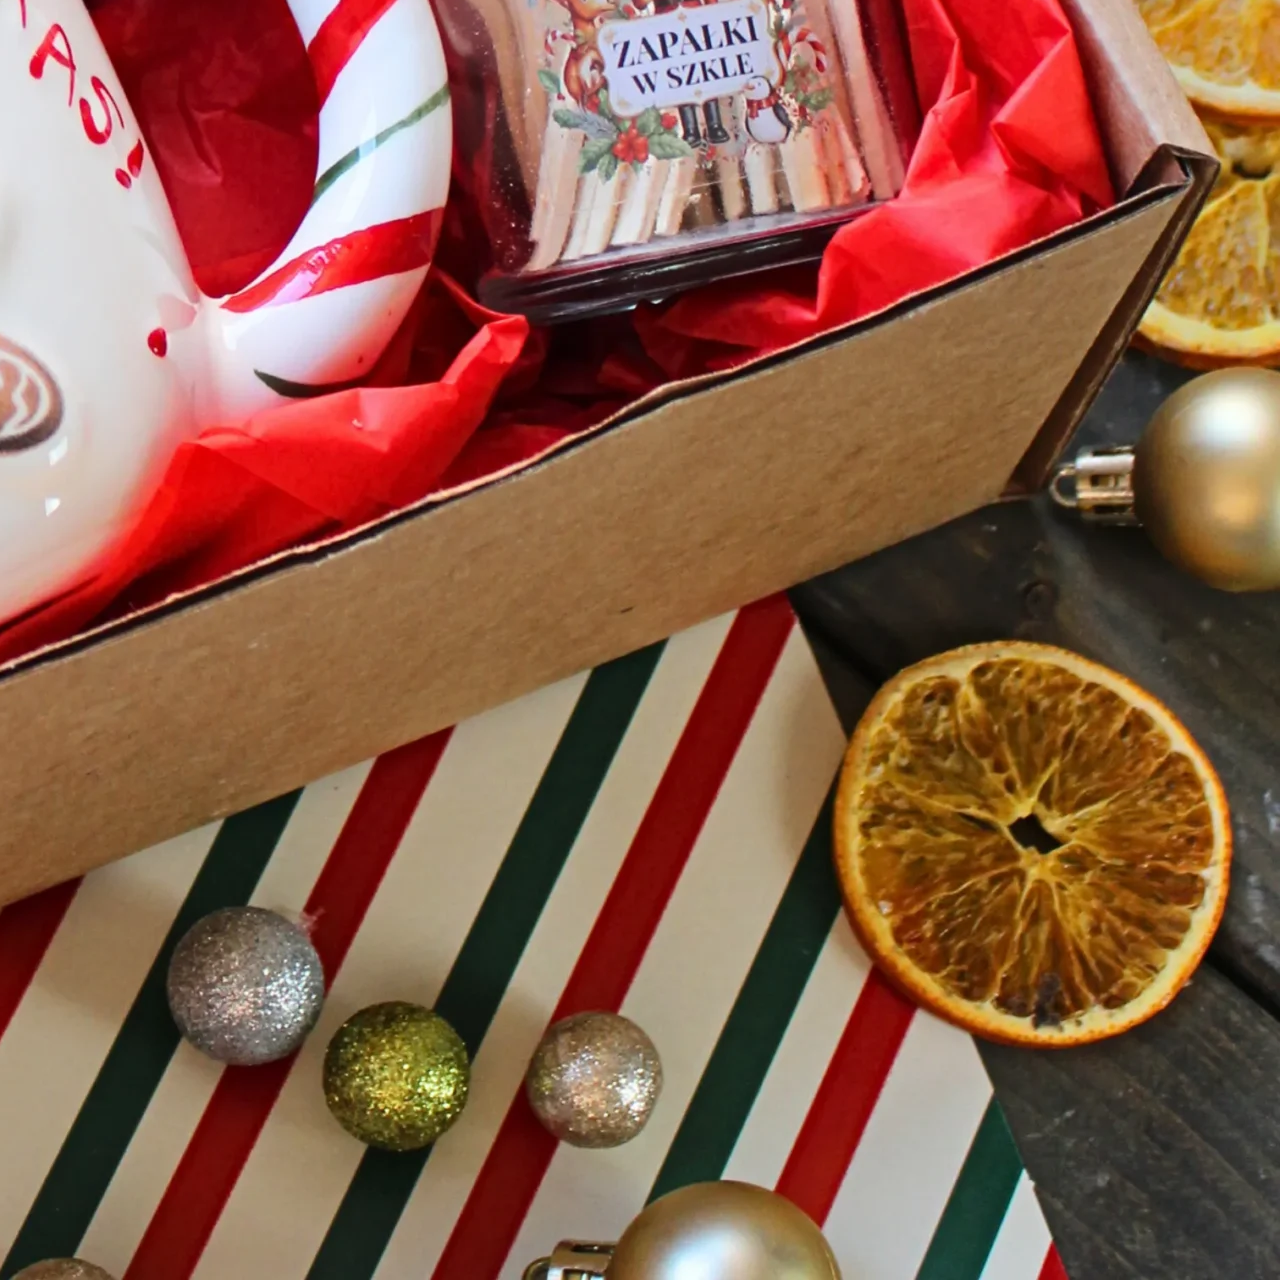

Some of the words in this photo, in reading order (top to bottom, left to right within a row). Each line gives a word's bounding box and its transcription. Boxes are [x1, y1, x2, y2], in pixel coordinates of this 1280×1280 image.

[612, 16, 759, 69] ZAPAŁKI
[631, 71, 660, 95] W
[667, 52, 754, 89] SZKLE
